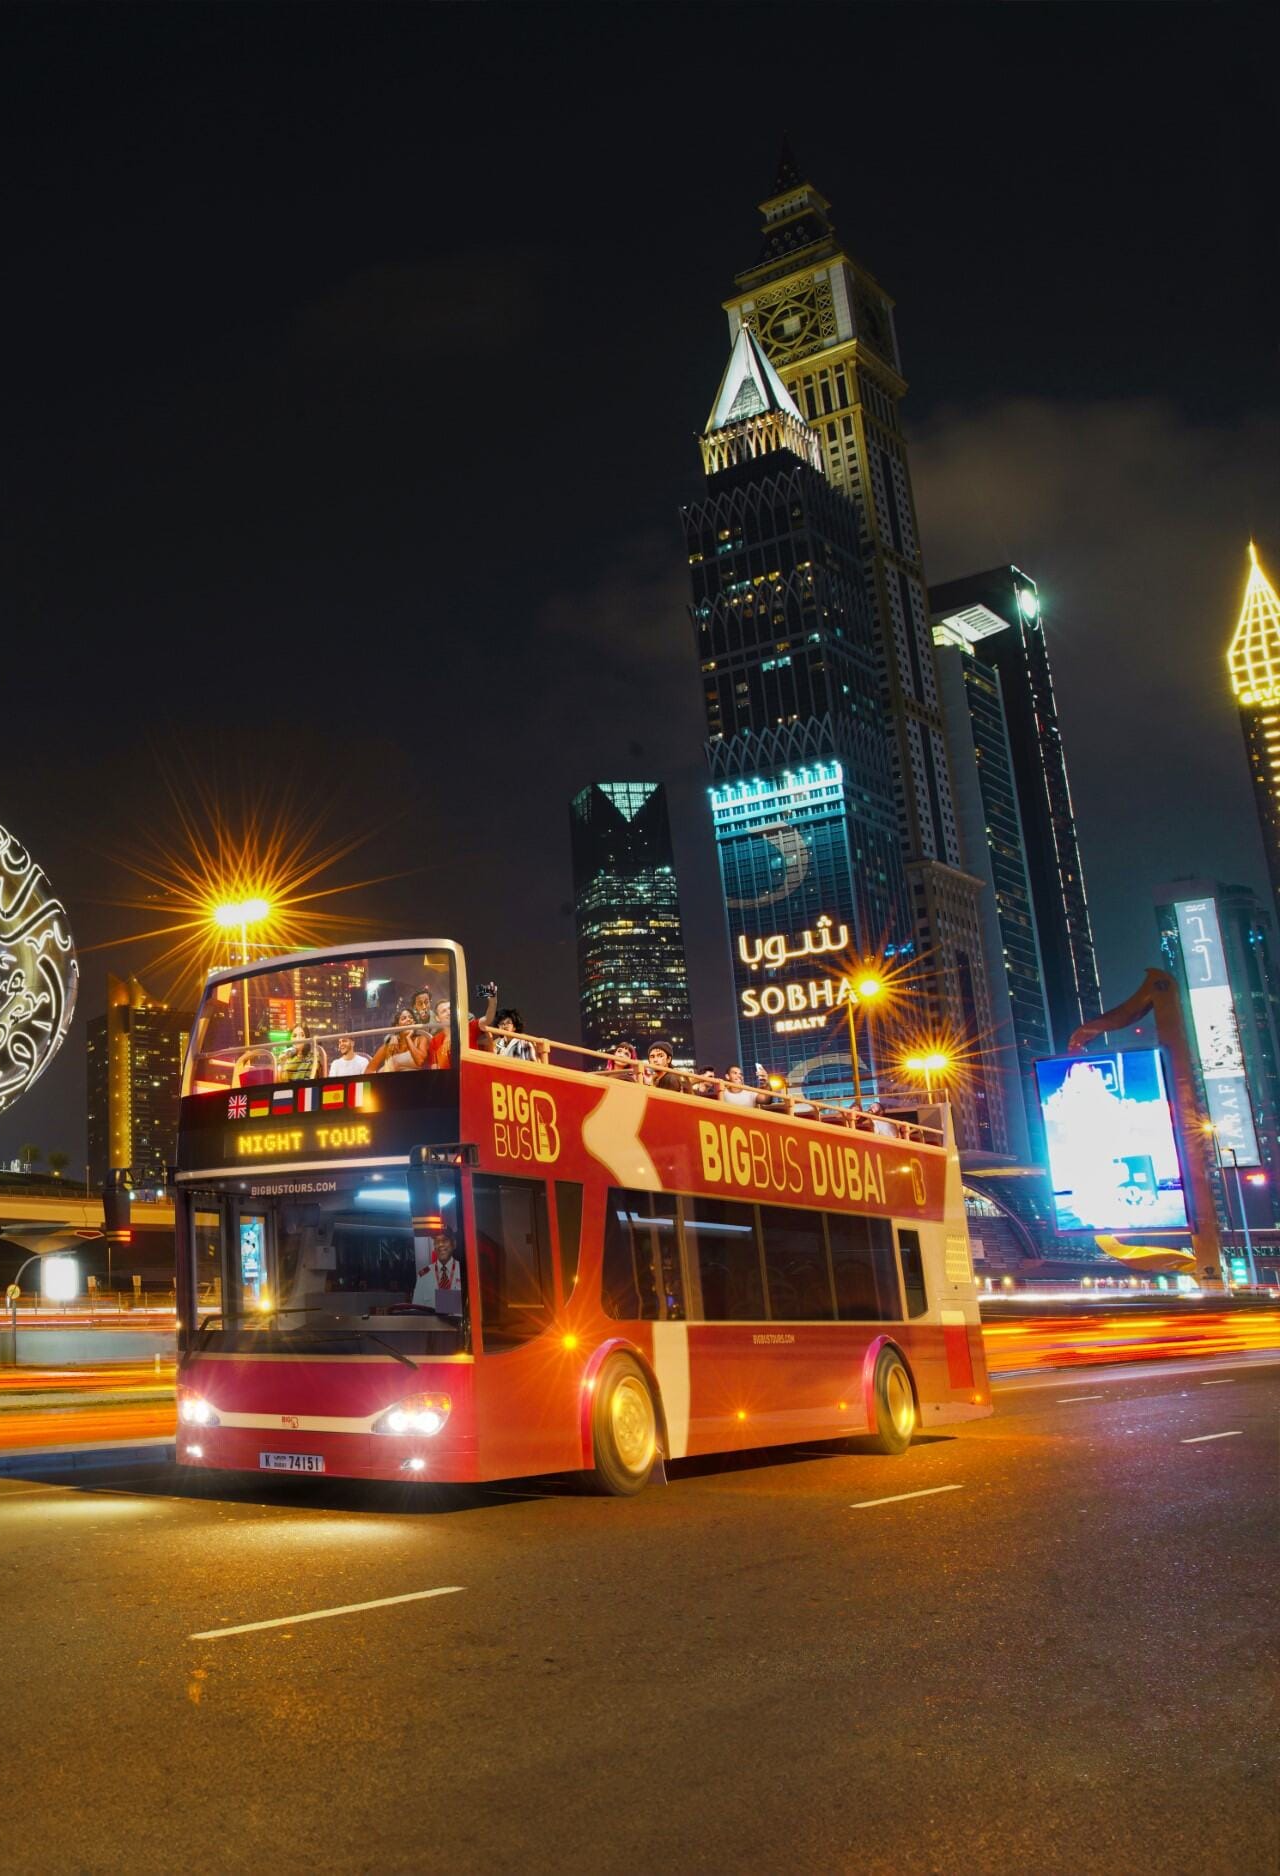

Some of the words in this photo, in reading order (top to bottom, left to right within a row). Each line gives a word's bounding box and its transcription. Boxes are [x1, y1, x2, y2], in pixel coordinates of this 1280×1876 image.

[741, 977, 858, 1017] SOBHA
[775, 1015, 827, 1033] REALTY
[491, 1082, 530, 1124] BIG
[1218, 1084, 1246, 1149] TARAF
[238, 1132, 303, 1155] NIGHT
[316, 1126, 371, 1149] TOUR
[494, 1123, 533, 1160] BUS
[250, 1181, 337, 1196] BIGBUSTOURS.COM
[808, 1141, 887, 1205] DUBAI
[288, 1455, 319, 1471] 74151
